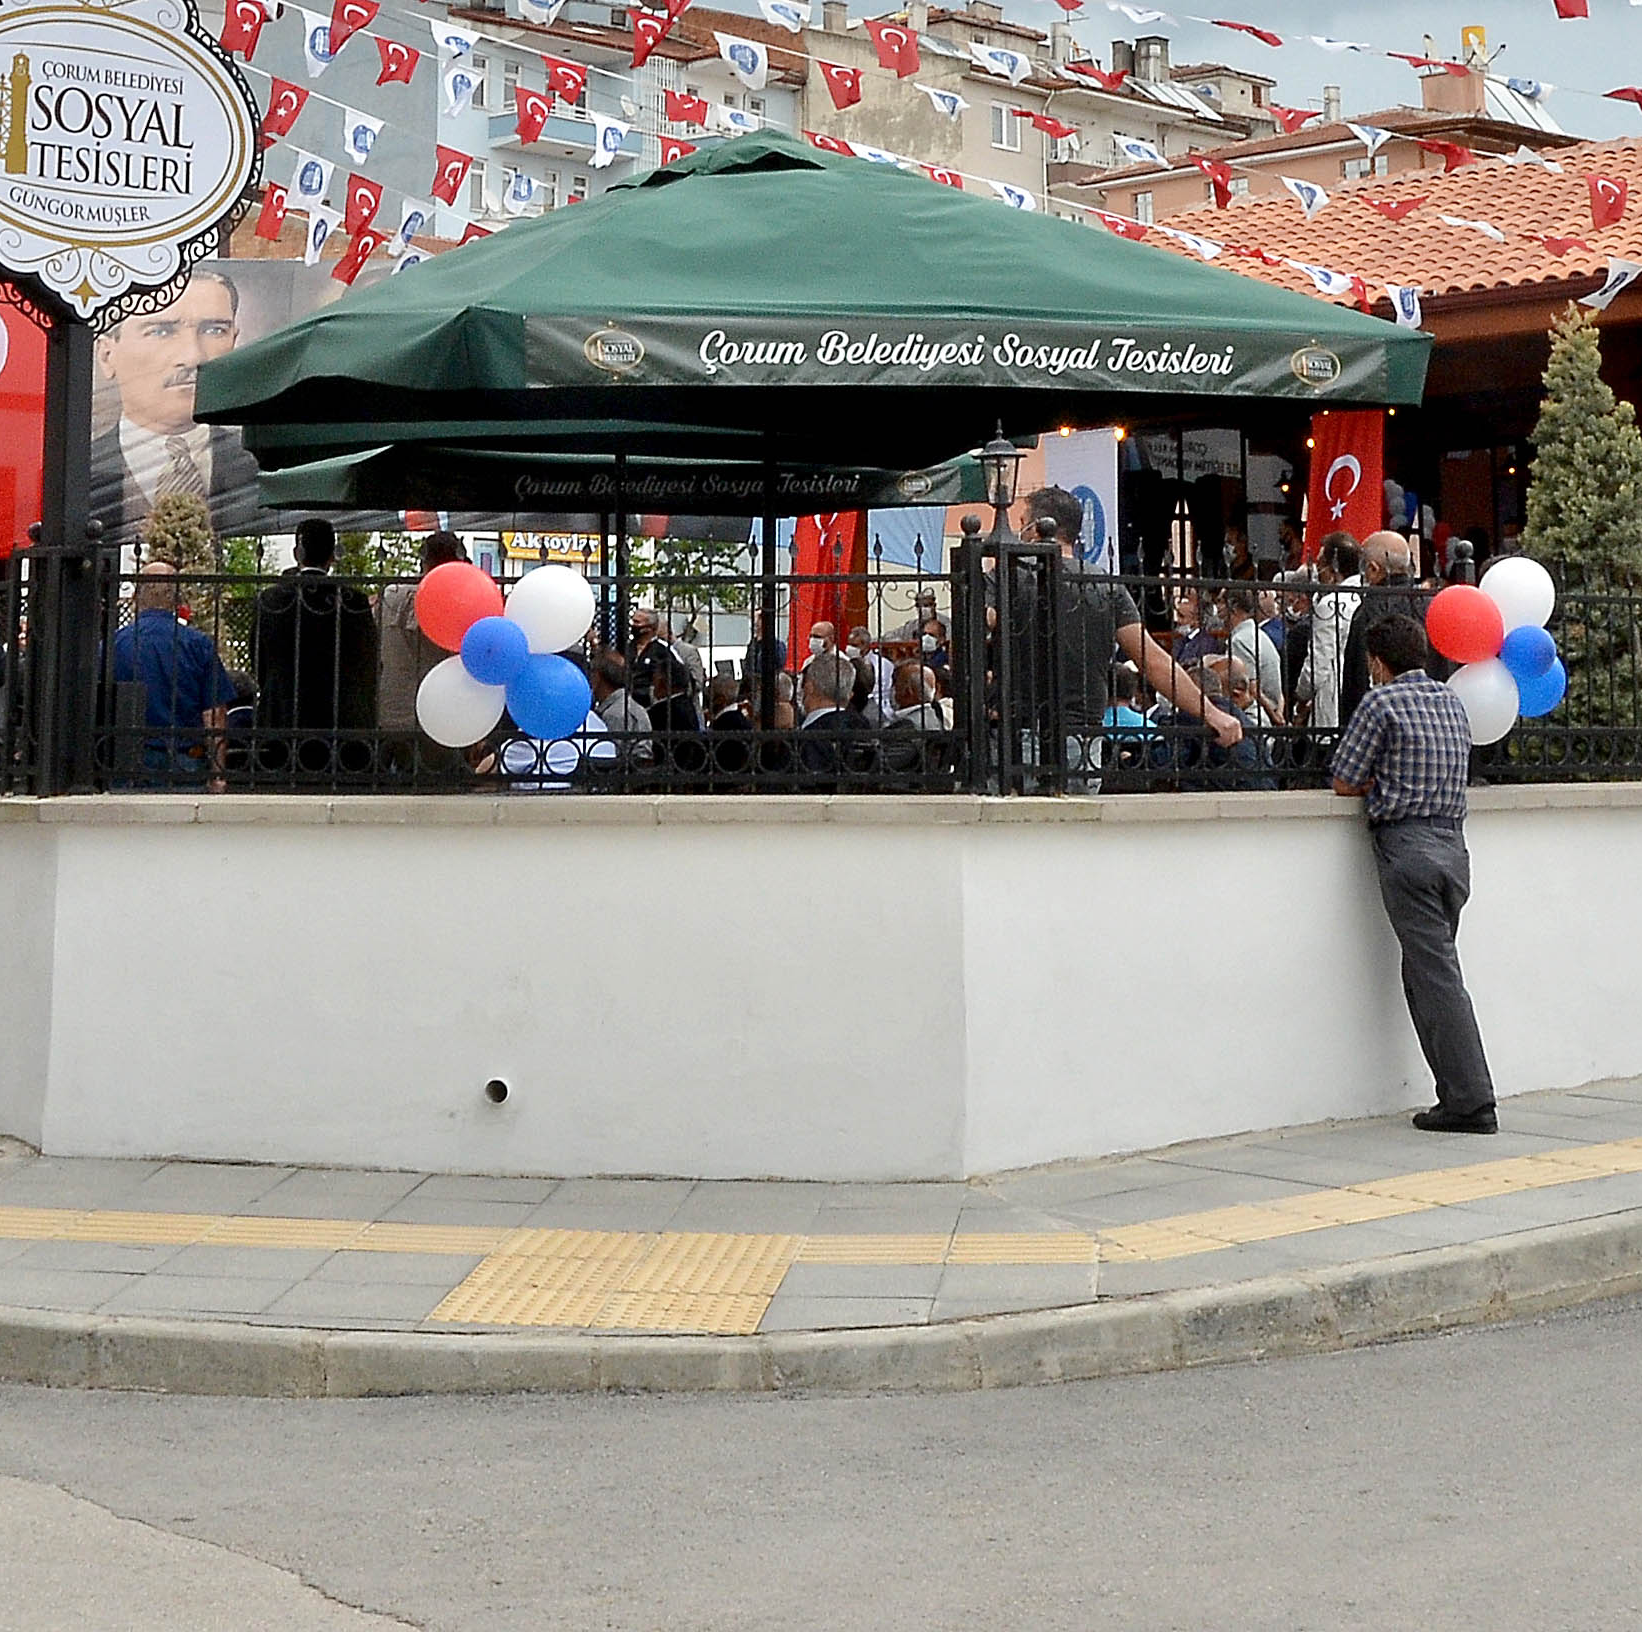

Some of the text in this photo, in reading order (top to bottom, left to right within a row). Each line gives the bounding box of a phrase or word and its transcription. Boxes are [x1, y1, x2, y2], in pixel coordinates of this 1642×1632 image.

[42, 60, 184, 95] ÇORUM BELEDİYESİ
[31, 85, 194, 149] SOSYAL
[30, 141, 192, 194] TESİSLERİ
[9, 186, 150, 226] GÜNGÖRMÜŞLER
[698, 330, 1234, 376] Çorum Belediyesi Sosyal Tesisleri
[514, 473, 861, 502] Çorum Beediyesi Sosya Tesisleri
